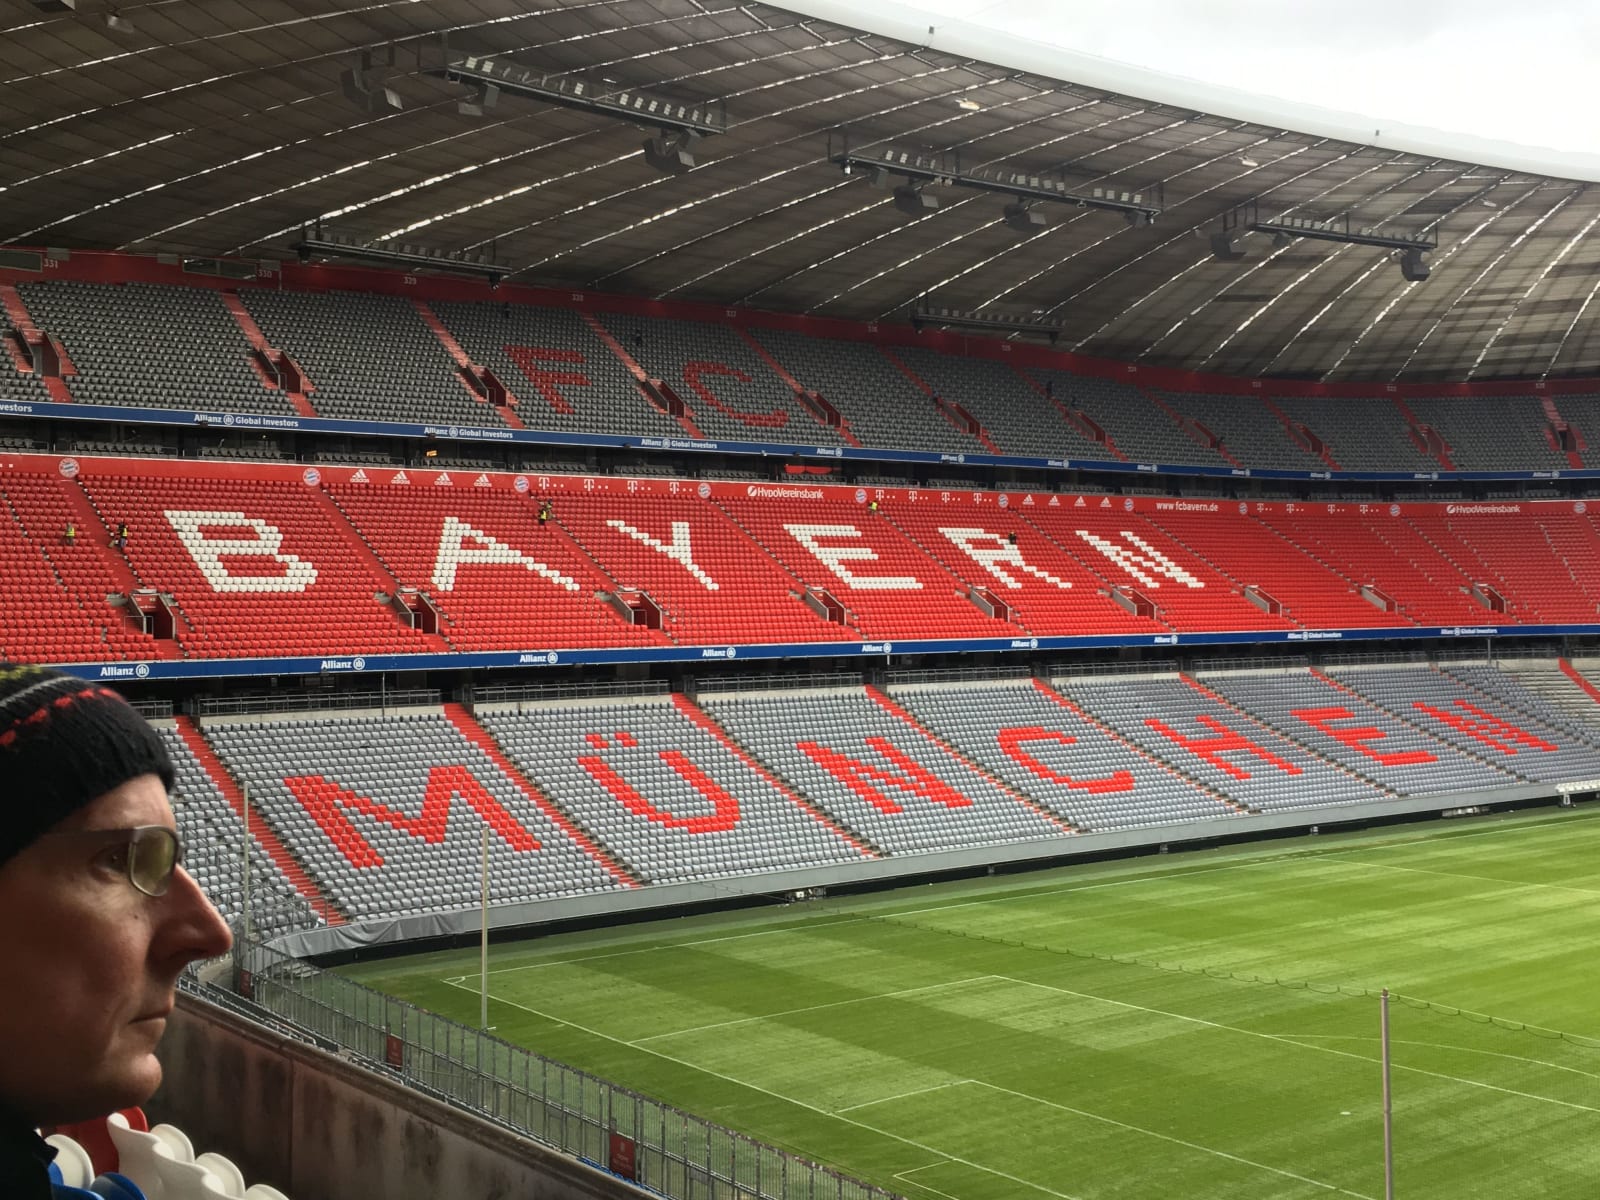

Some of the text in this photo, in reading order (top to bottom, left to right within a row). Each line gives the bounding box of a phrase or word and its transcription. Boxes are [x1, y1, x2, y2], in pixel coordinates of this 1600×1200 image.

[193, 413, 299, 428] Allianz Global Investors
[423, 426, 513, 439] Allianz Global Investors
[640, 438, 662, 447] Allianz
[757, 486, 824, 499] HypoVereinsbank
[163, 510, 1205, 593] BAYERN
[702, 649, 726, 658] Allianz
[861, 644, 883, 653] Allianz
[320, 659, 352, 670] Allianz
[519, 654, 547, 664] Allianz
[100, 665, 134, 677] Allianz
